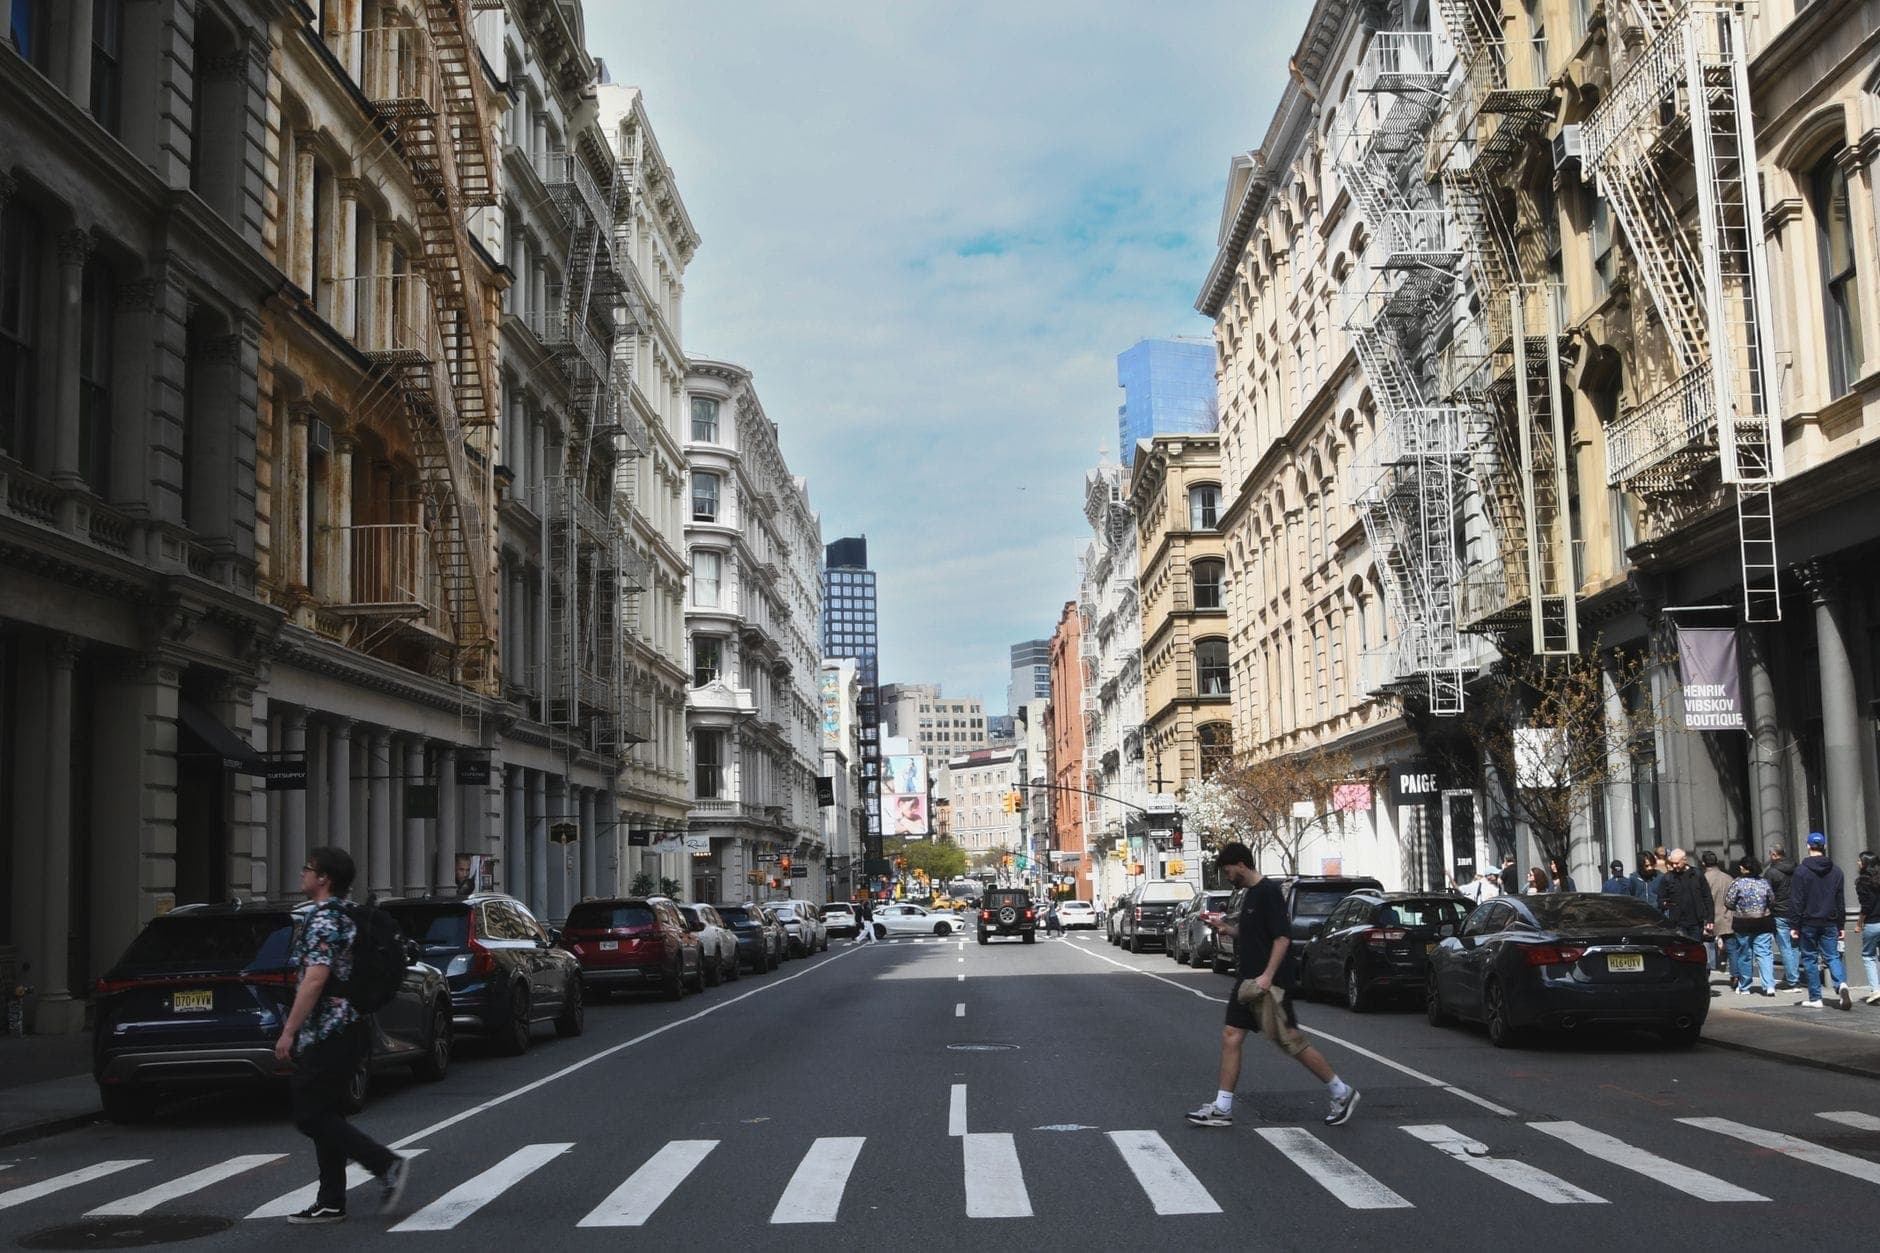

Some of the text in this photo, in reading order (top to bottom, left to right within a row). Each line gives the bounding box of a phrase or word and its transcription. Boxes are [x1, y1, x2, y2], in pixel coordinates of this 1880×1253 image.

[1683, 685, 1726, 697] HENRIK
[1684, 699, 1734, 711] VIBSKOV
[1685, 713, 1743, 726] BOUTIQUE
[1400, 774, 1438, 794] PAIGE
